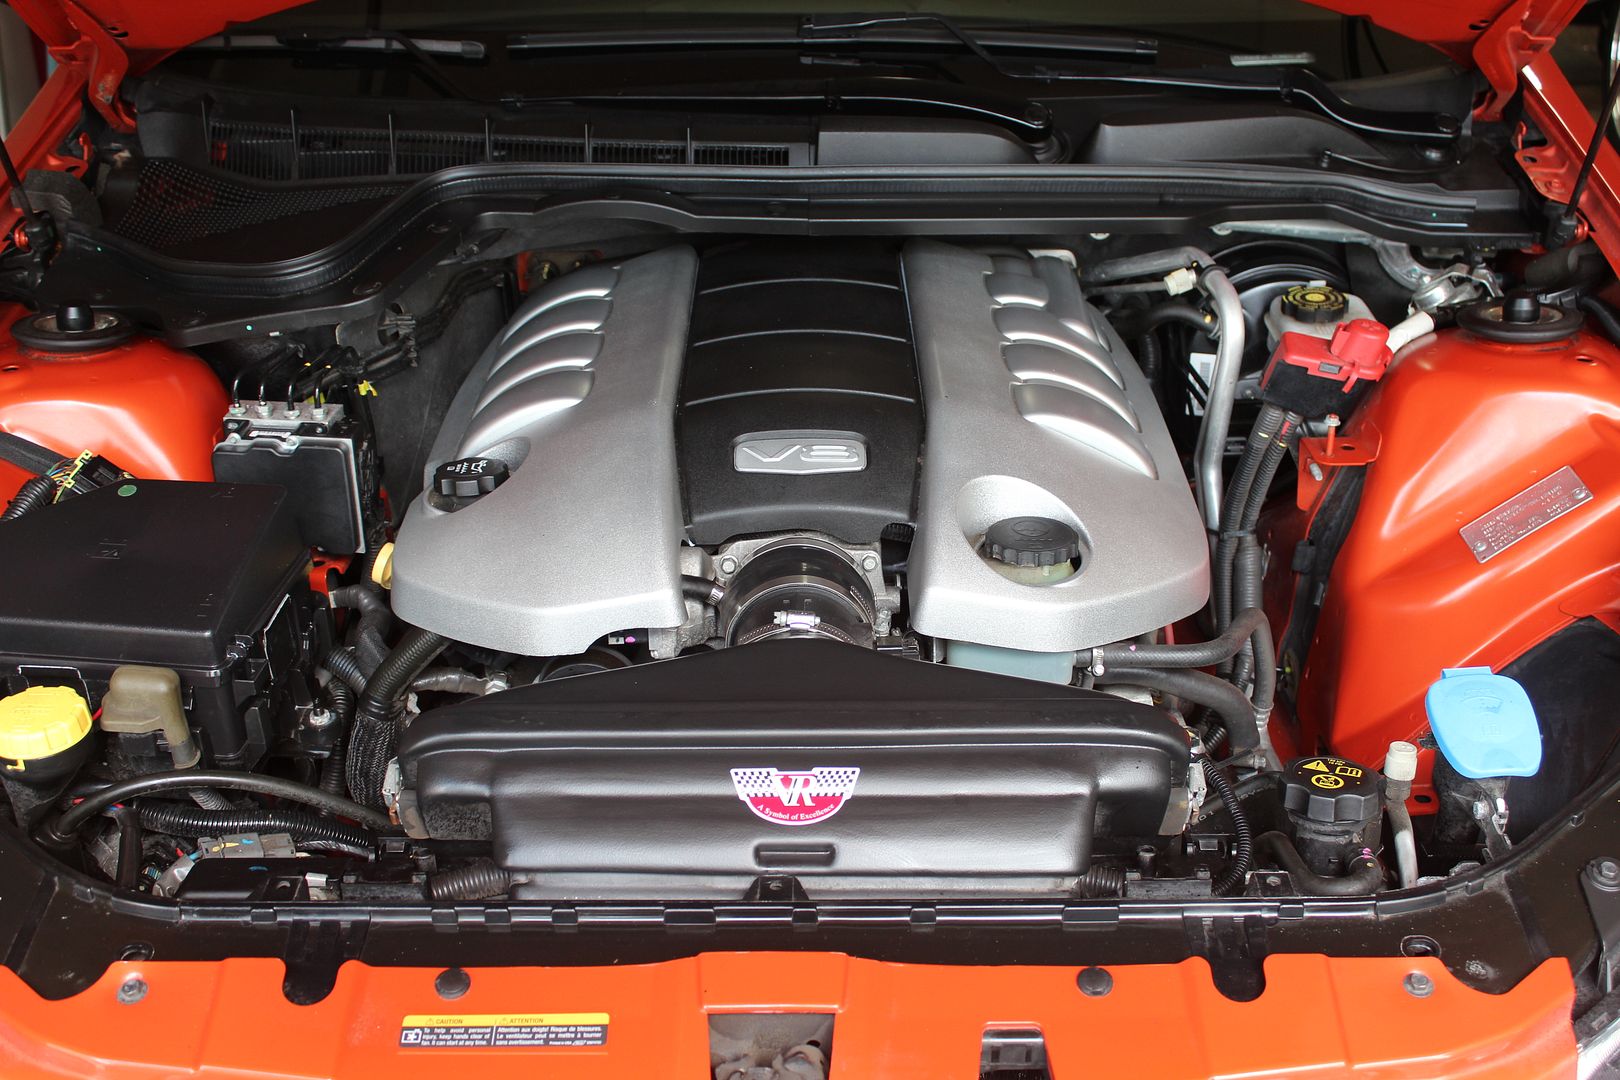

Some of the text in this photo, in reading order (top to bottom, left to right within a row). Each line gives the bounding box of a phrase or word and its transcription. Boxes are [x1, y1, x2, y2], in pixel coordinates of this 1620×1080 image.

[774, 775, 817, 807] VR
[765, 808, 789, 820] Symbol
[800, 804, 834, 820] Excellence
